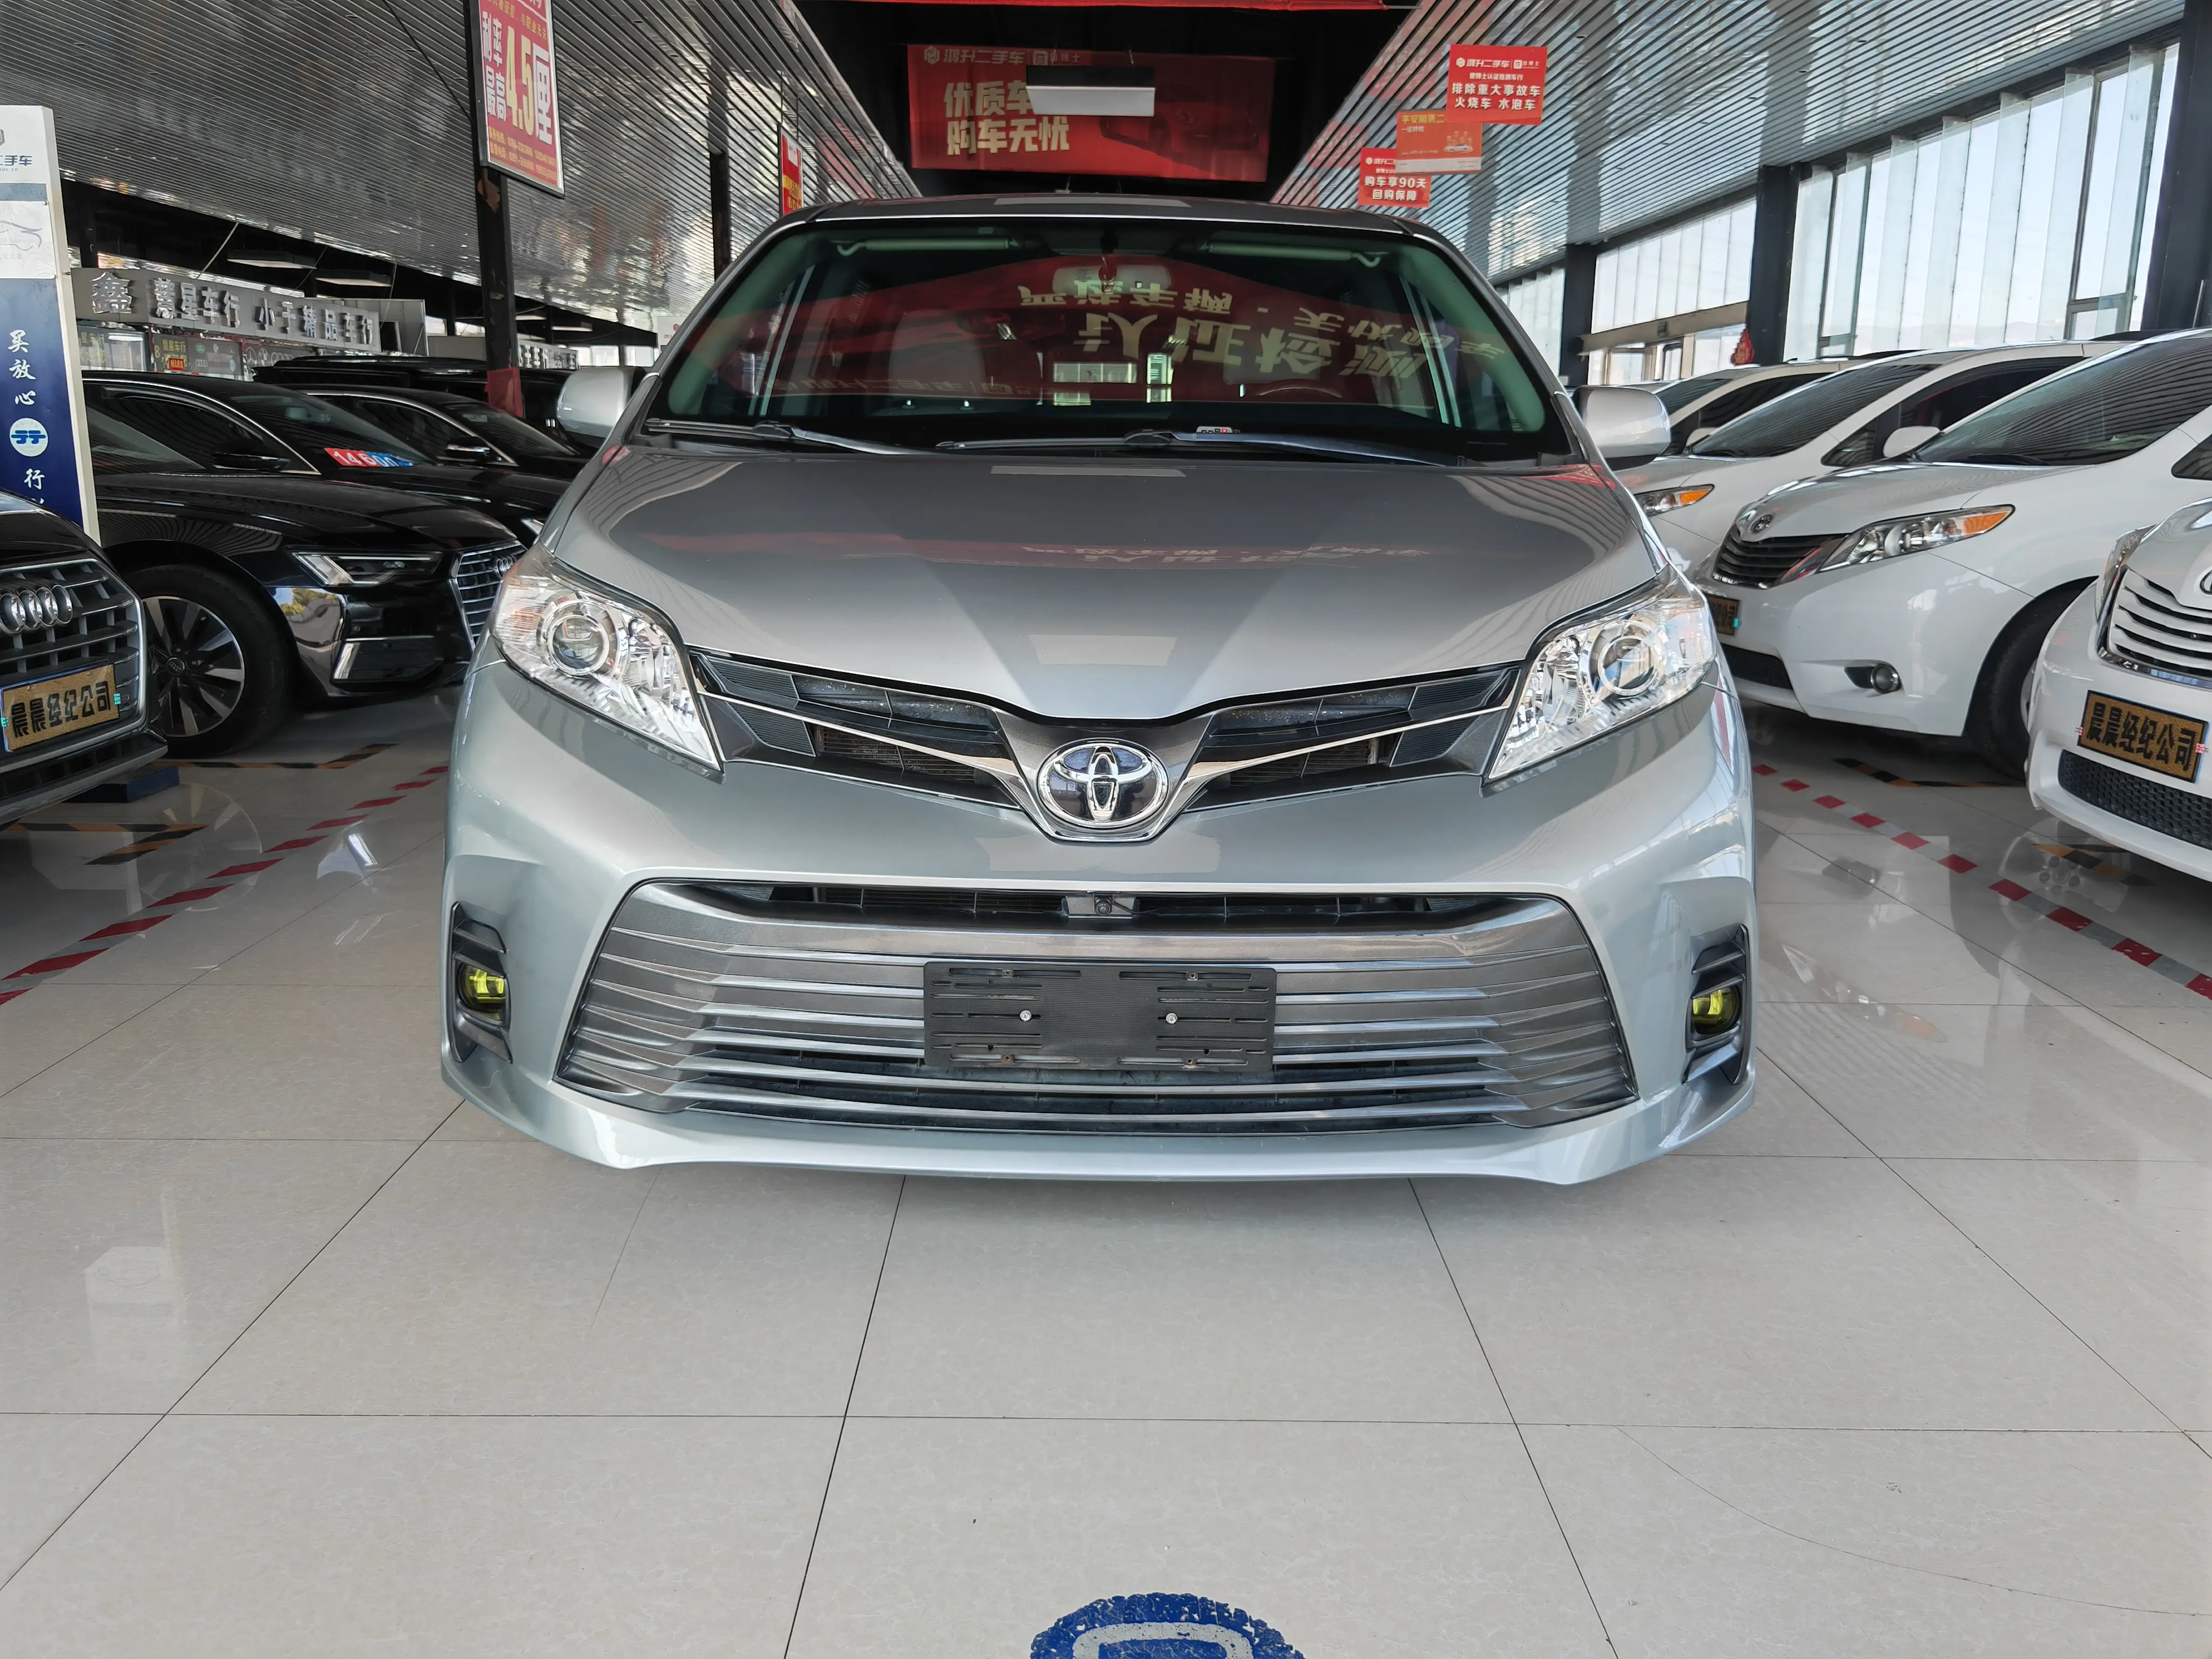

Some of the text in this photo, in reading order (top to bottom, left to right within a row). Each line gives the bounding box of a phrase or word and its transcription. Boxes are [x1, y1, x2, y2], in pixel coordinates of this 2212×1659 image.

[482, 11, 502, 67] 利率
[486, 65, 506, 122] 最高
[506, 25, 552, 145] 4.5厘
[1452, 83, 1541, 97] 排除重大事故车
[943, 80, 1034, 118] 优质车
[1455, 97, 1536, 111] 火烧车 水泡车
[1401, 114, 1445, 124] 平安租赁二
[947, 116, 1070, 155] 购车无忧
[0, 155, 32, 166] 手车
[1364, 176, 1427, 188] 购车享90天
[1372, 189, 1417, 201] 回购保障
[8, 329, 36, 405] 买放心
